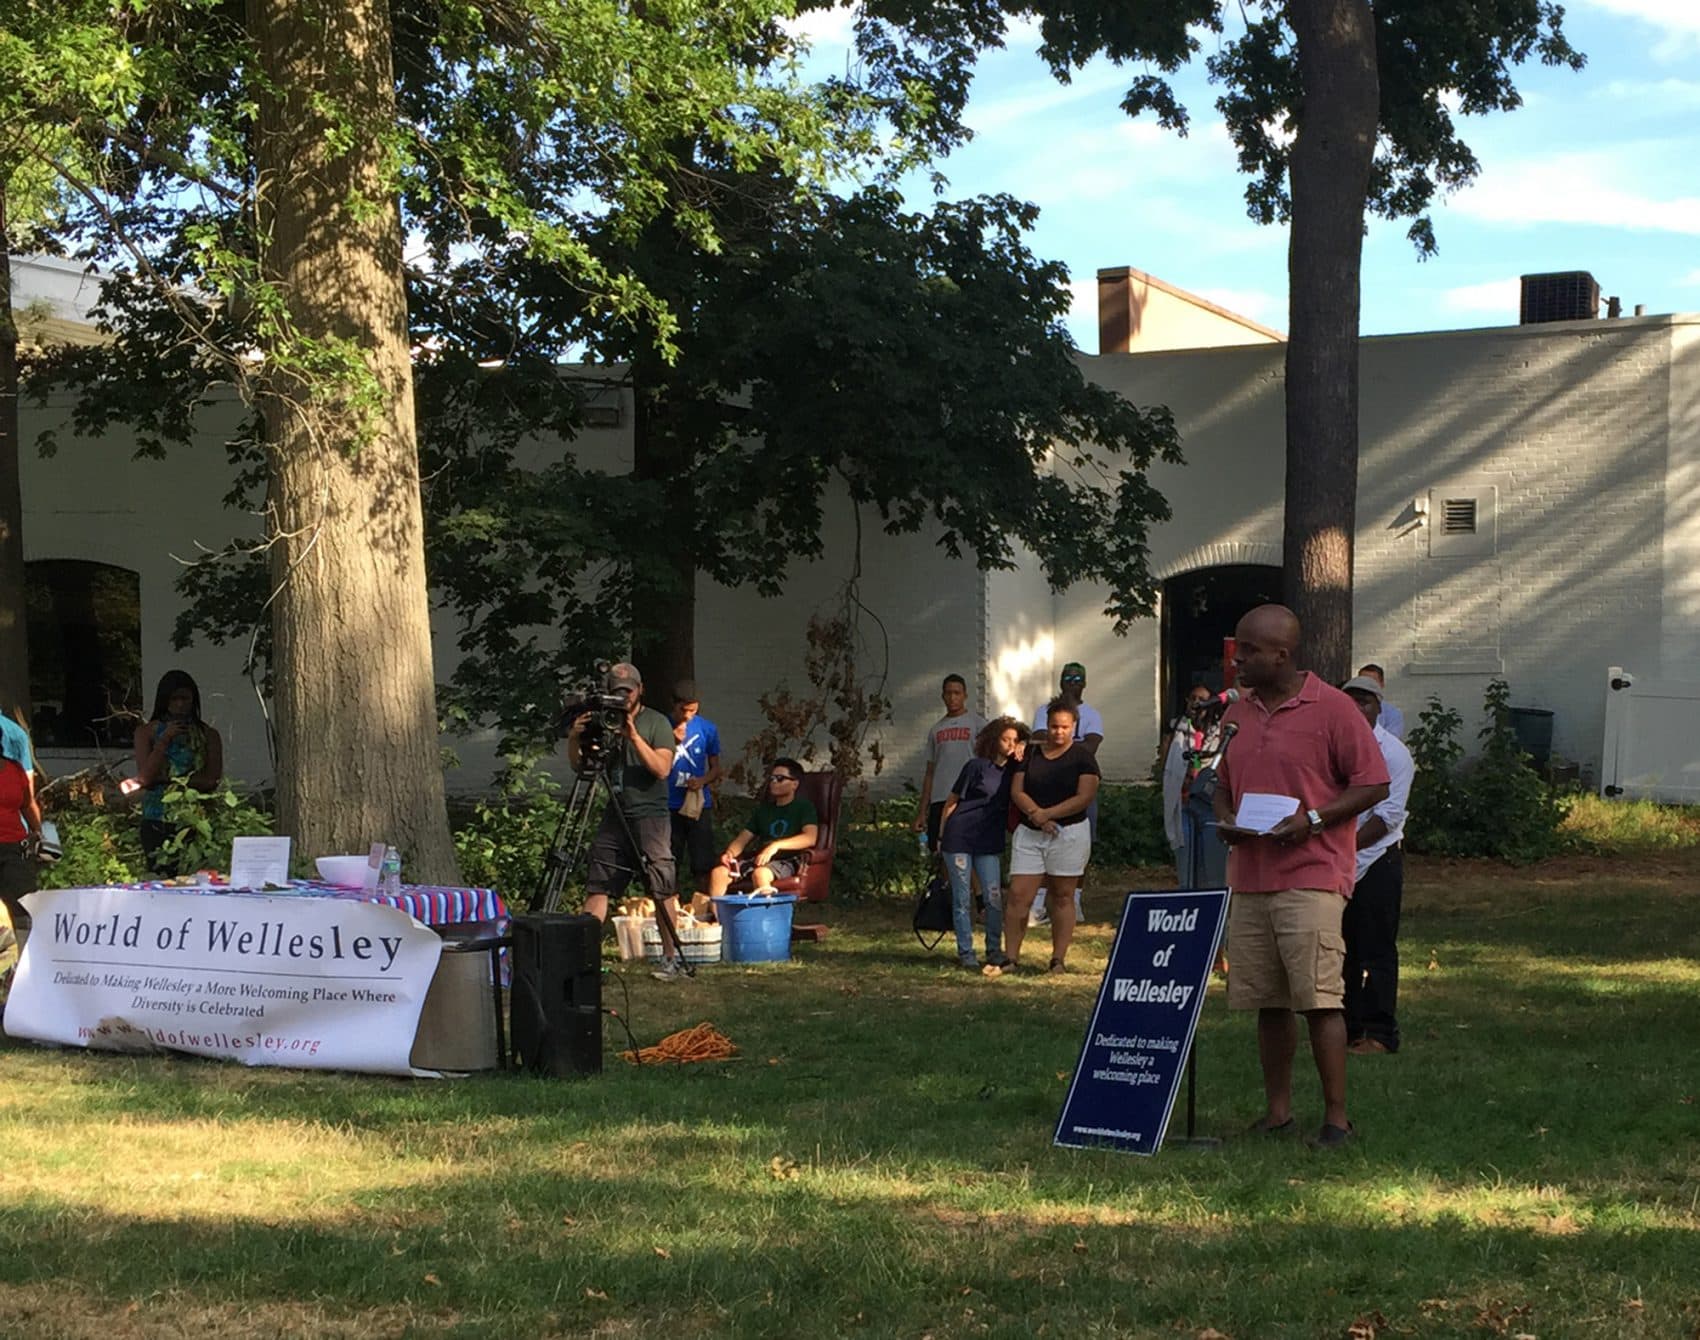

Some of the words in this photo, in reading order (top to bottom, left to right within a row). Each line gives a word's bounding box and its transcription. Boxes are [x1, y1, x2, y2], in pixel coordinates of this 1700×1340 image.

[1147, 908, 1199, 932] World
[55, 912, 142, 948] World
[156, 917, 193, 950] of
[208, 920, 403, 972] Wellesley
[1152, 944, 1175, 967] of
[89, 974, 99, 986] to
[100, 974, 142, 991] Making
[143, 976, 192, 995] Wellesley
[195, 983, 202, 994] a
[202, 981, 236, 996] More
[239, 983, 309, 1004] Welcoming
[312, 988, 348, 1001] Place
[352, 989, 396, 1003] Where
[1113, 979, 1194, 1010] Wellesley
[131, 996, 183, 1015] Diversity
[186, 1000, 196, 1014] is
[199, 1000, 264, 1018] Celebrated
[77, 1025, 321, 1055] www.wldofwellesley.org
[1095, 1033, 1137, 1048] Dedicated
[1137, 1038, 1146, 1049] to
[1146, 1036, 1179, 1053] making
[1109, 1050, 1149, 1069] Wellesley
[1147, 1056, 1155, 1067] a
[1093, 1067, 1137, 1085] welcoming
[1136, 1070, 1160, 1086] place
